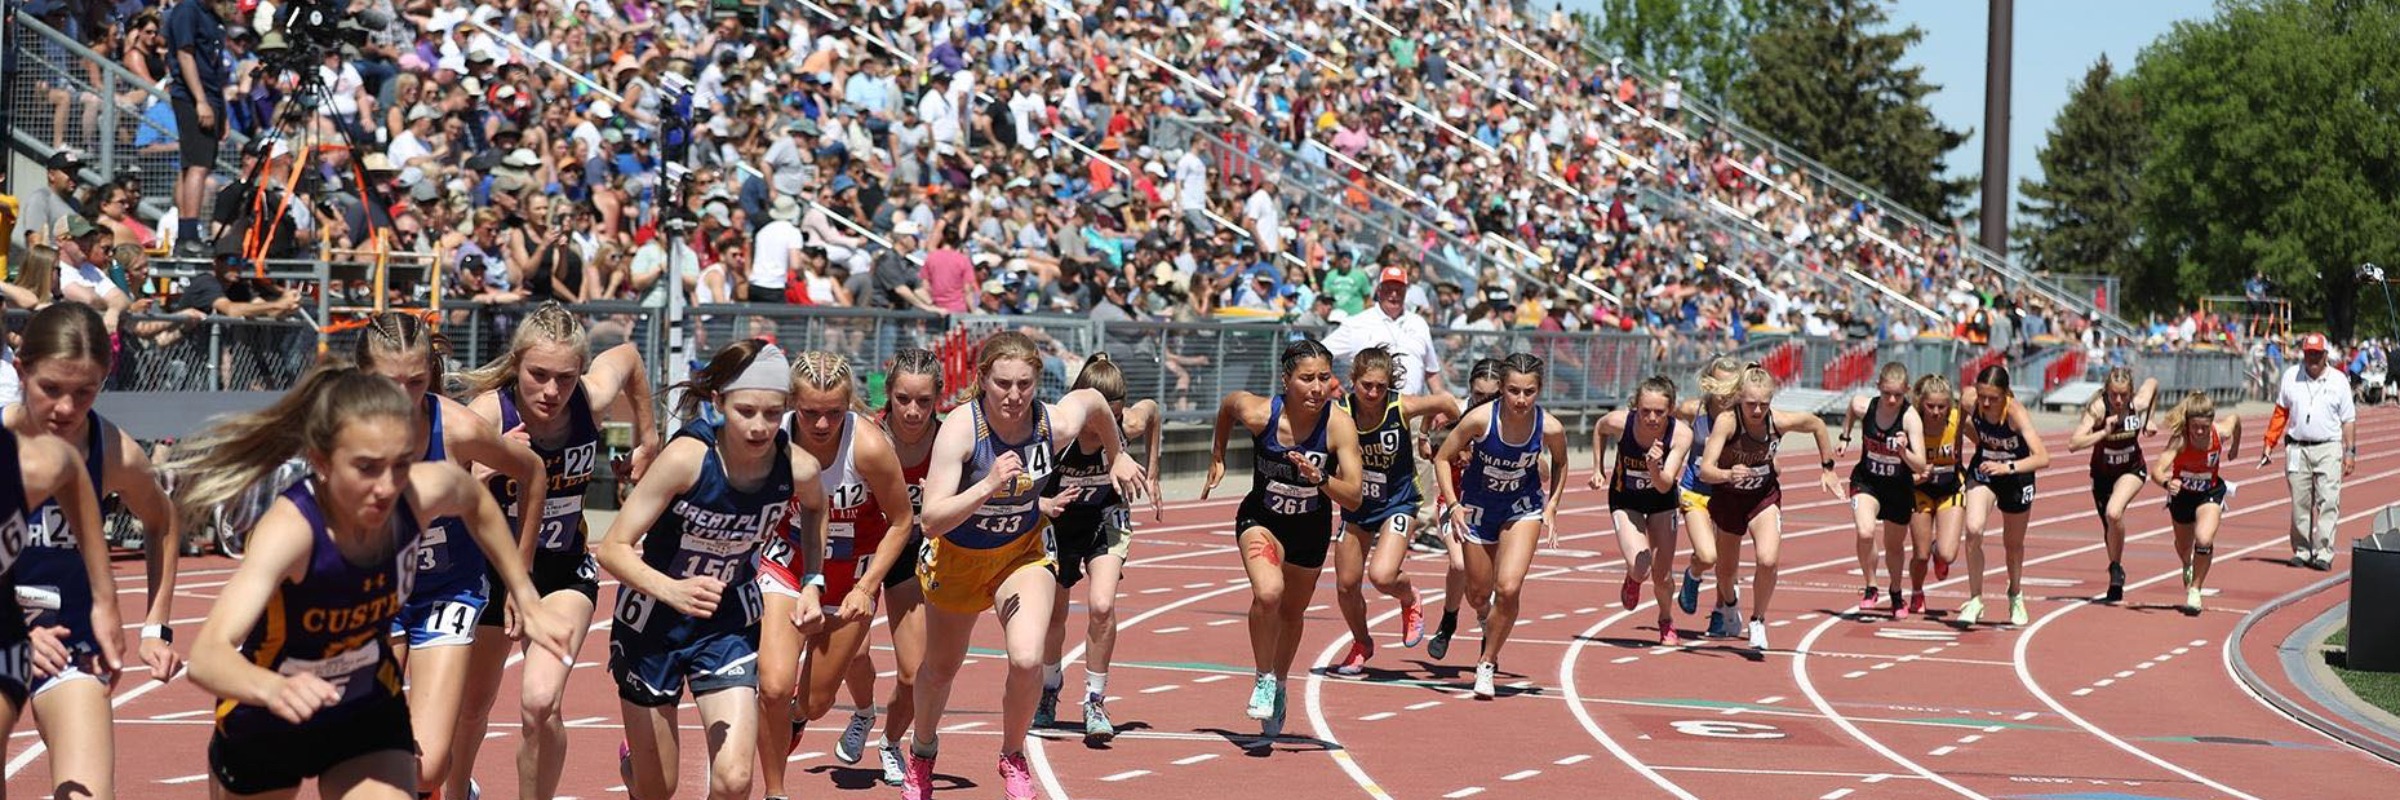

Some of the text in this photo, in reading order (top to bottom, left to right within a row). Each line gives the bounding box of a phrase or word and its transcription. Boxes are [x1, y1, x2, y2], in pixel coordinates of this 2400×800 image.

[1384, 432, 1397, 452] 9
[567, 444, 594, 476] 22
[1033, 444, 1048, 475] 4
[1871, 460, 1894, 477] 119
[1488, 478, 1520, 492] 270
[1734, 476, 1764, 491] 222
[2182, 477, 2206, 492] 232
[836, 484, 863, 508] 12
[1270, 495, 1308, 515] 261
[673, 500, 735, 530] GREAT
[976, 515, 1022, 533] 133
[1393, 514, 1406, 533] 9
[766, 535, 791, 566] 12
[682, 555, 740, 583] 156
[622, 588, 648, 625] 6
[433, 602, 468, 635] 14
